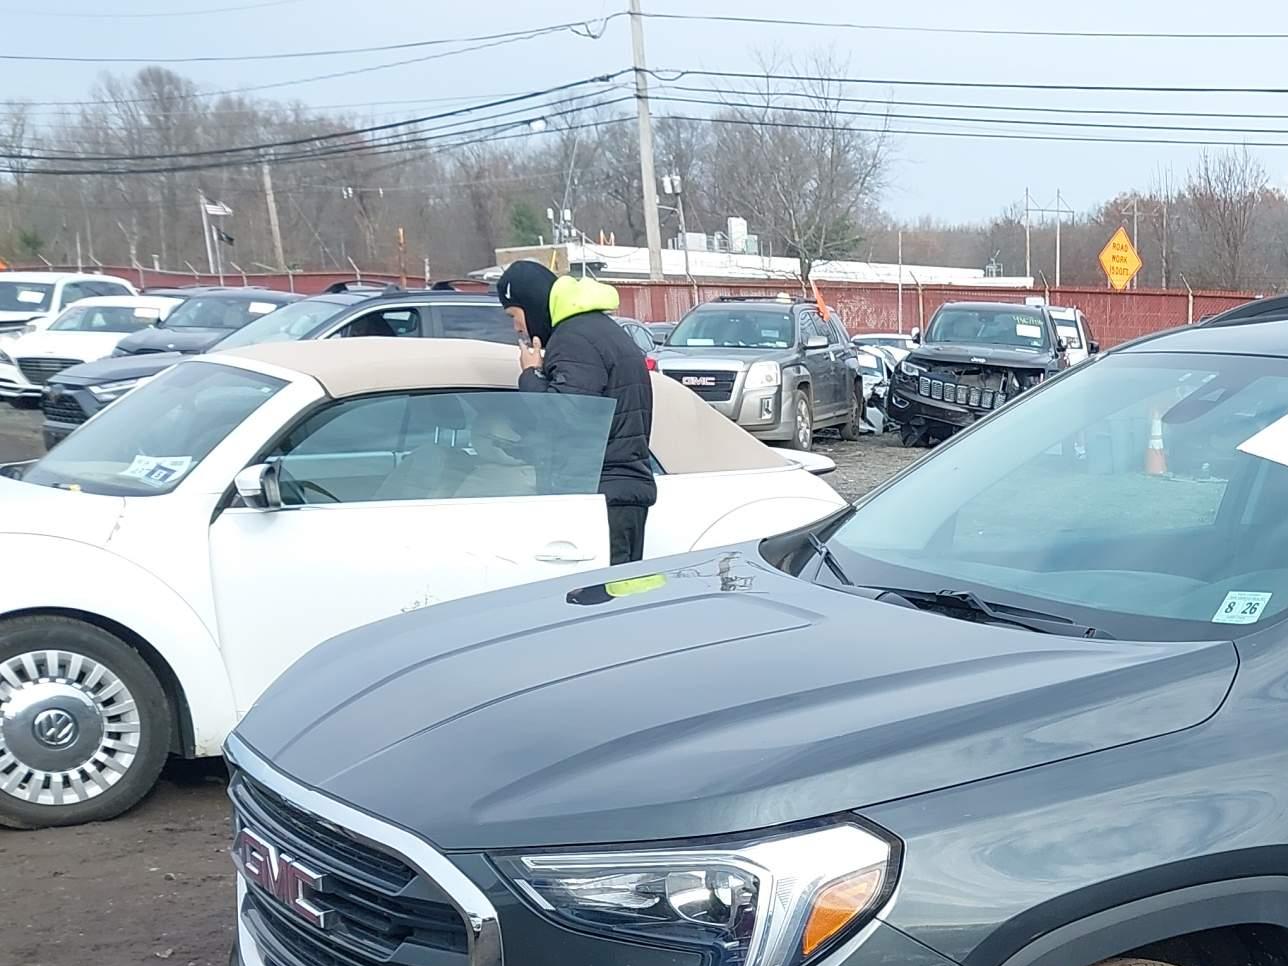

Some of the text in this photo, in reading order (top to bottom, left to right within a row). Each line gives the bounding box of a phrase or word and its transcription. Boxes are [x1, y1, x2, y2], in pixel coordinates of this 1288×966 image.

[1112, 242, 1128, 253] ROAD
[1111, 254, 1128, 264] WORK
[682, 376, 716, 386] GMC
[1225, 601, 1260, 614] 8 26
[236, 827, 327, 929] GMC
